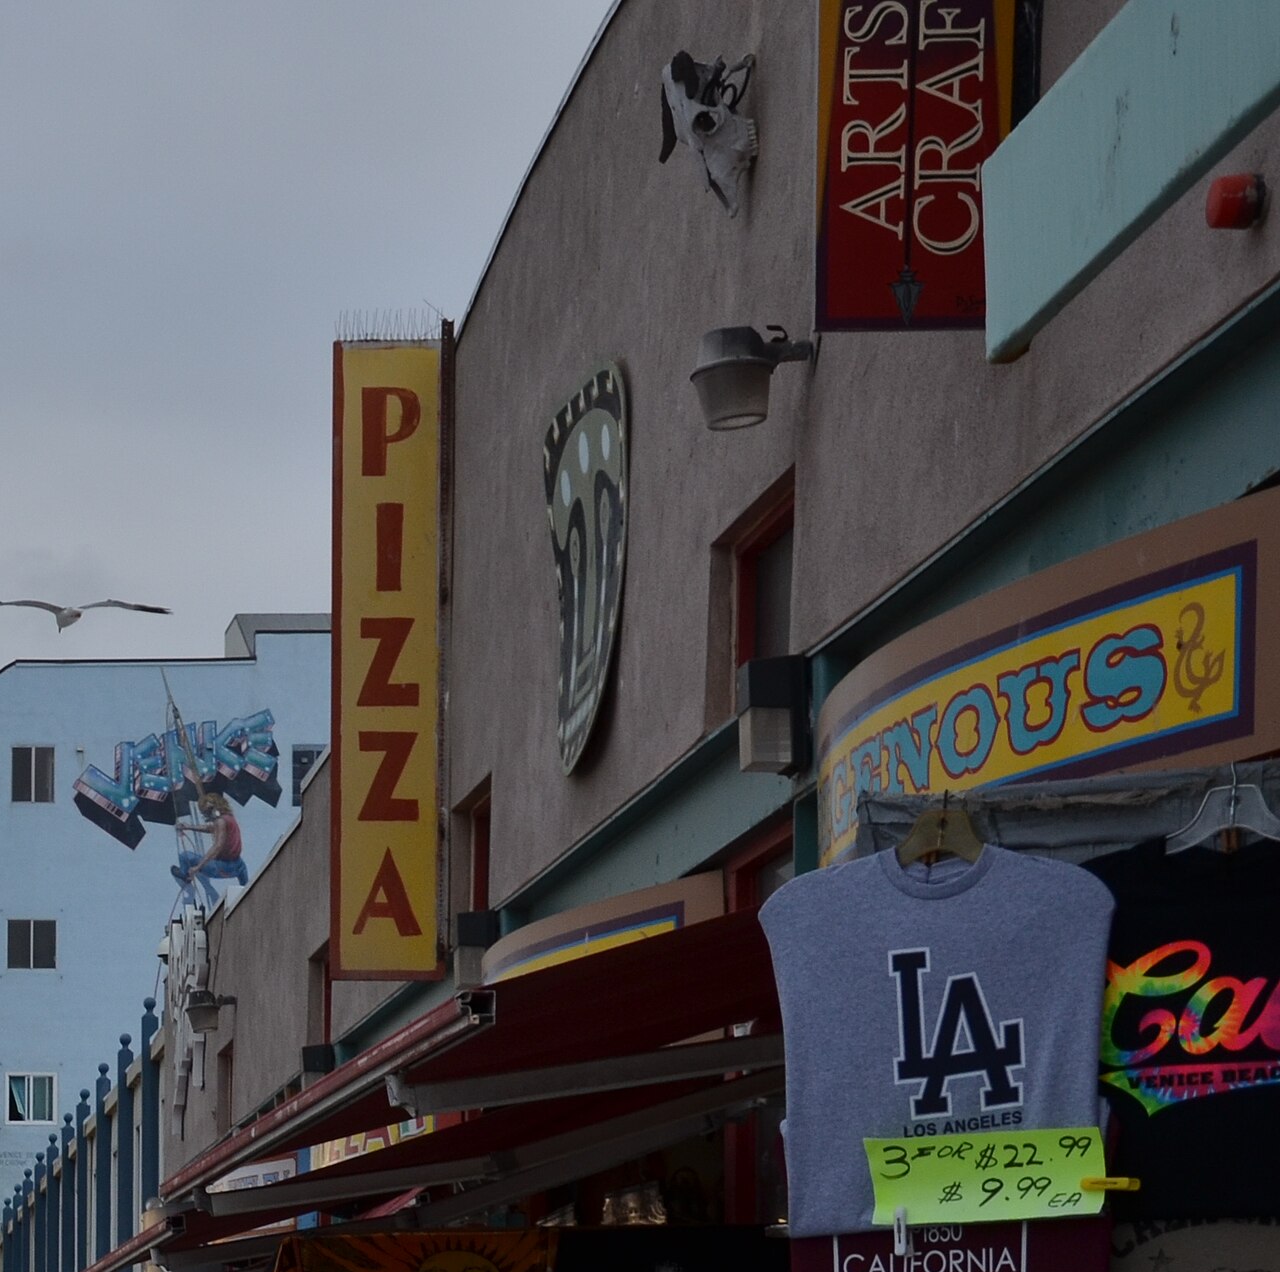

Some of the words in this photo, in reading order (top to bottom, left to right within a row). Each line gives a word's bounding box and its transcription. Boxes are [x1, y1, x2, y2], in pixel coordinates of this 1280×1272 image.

[840, 0, 908, 241] ARTS
[352, 386, 422, 936] PIZZA
[889, 947, 1025, 1120] LA
[1127, 1071, 1214, 1090] VENICE
[880, 1145, 911, 1179] 3
[903, 1123, 937, 1138] LOS
[943, 1111, 1022, 1134] ANGELES
